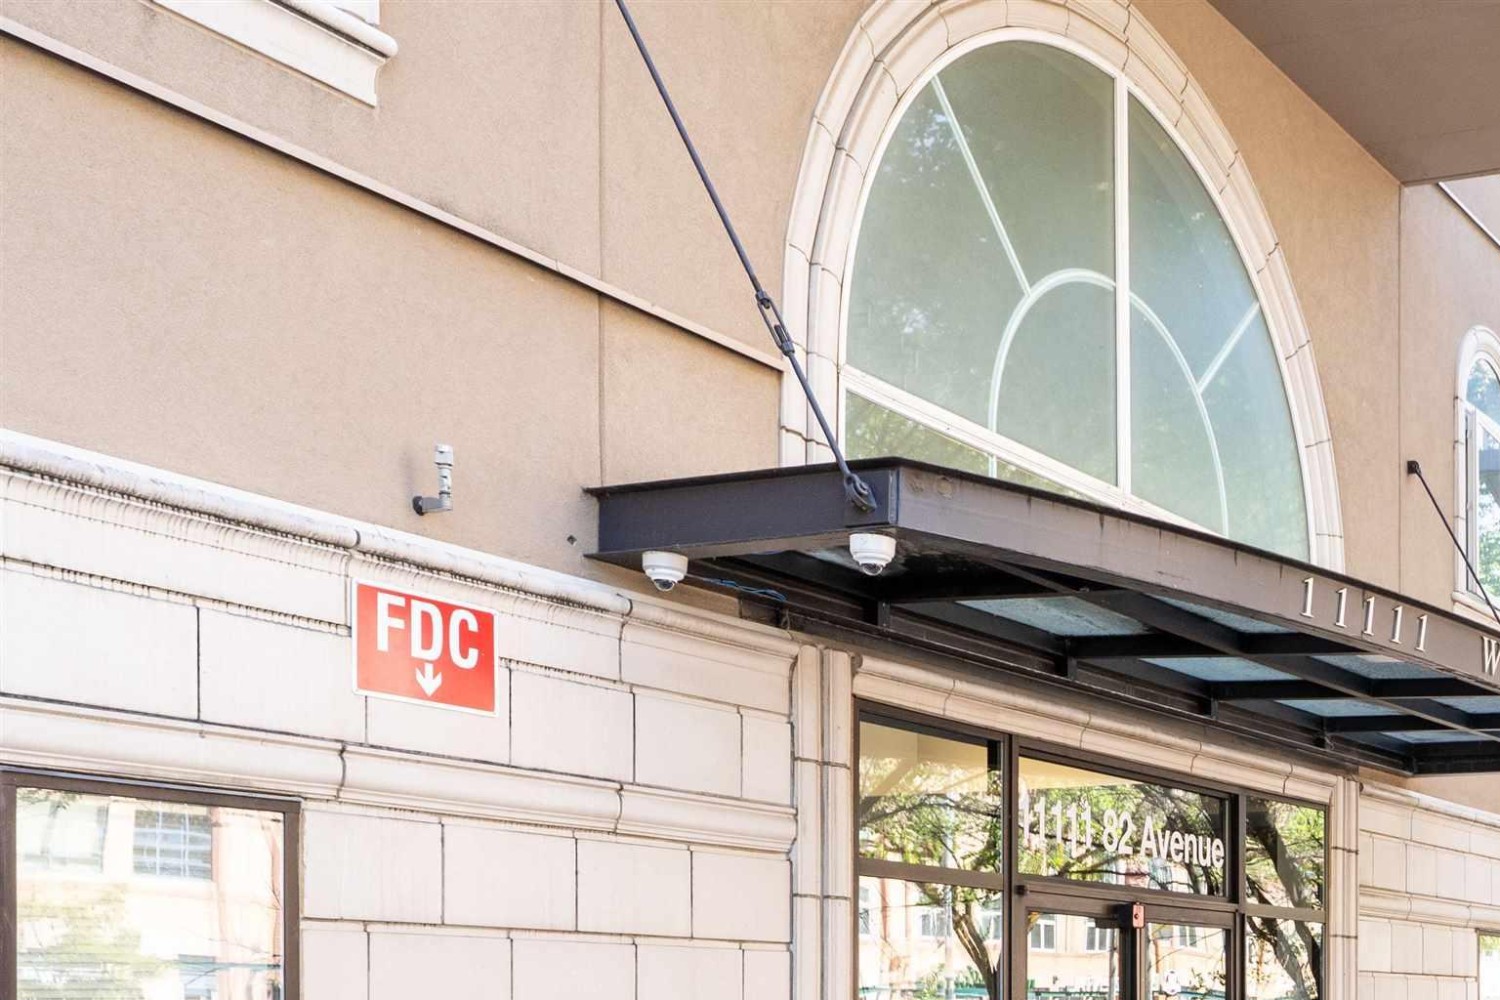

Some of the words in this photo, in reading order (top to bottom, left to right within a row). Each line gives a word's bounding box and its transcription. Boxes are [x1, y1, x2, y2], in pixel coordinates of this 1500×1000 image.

[377, 591, 479, 670] FDC
[1300, 577, 1428, 652] 11111
[1102, 808, 1134, 854] 82
[1139, 816, 1225, 868] Avenue
